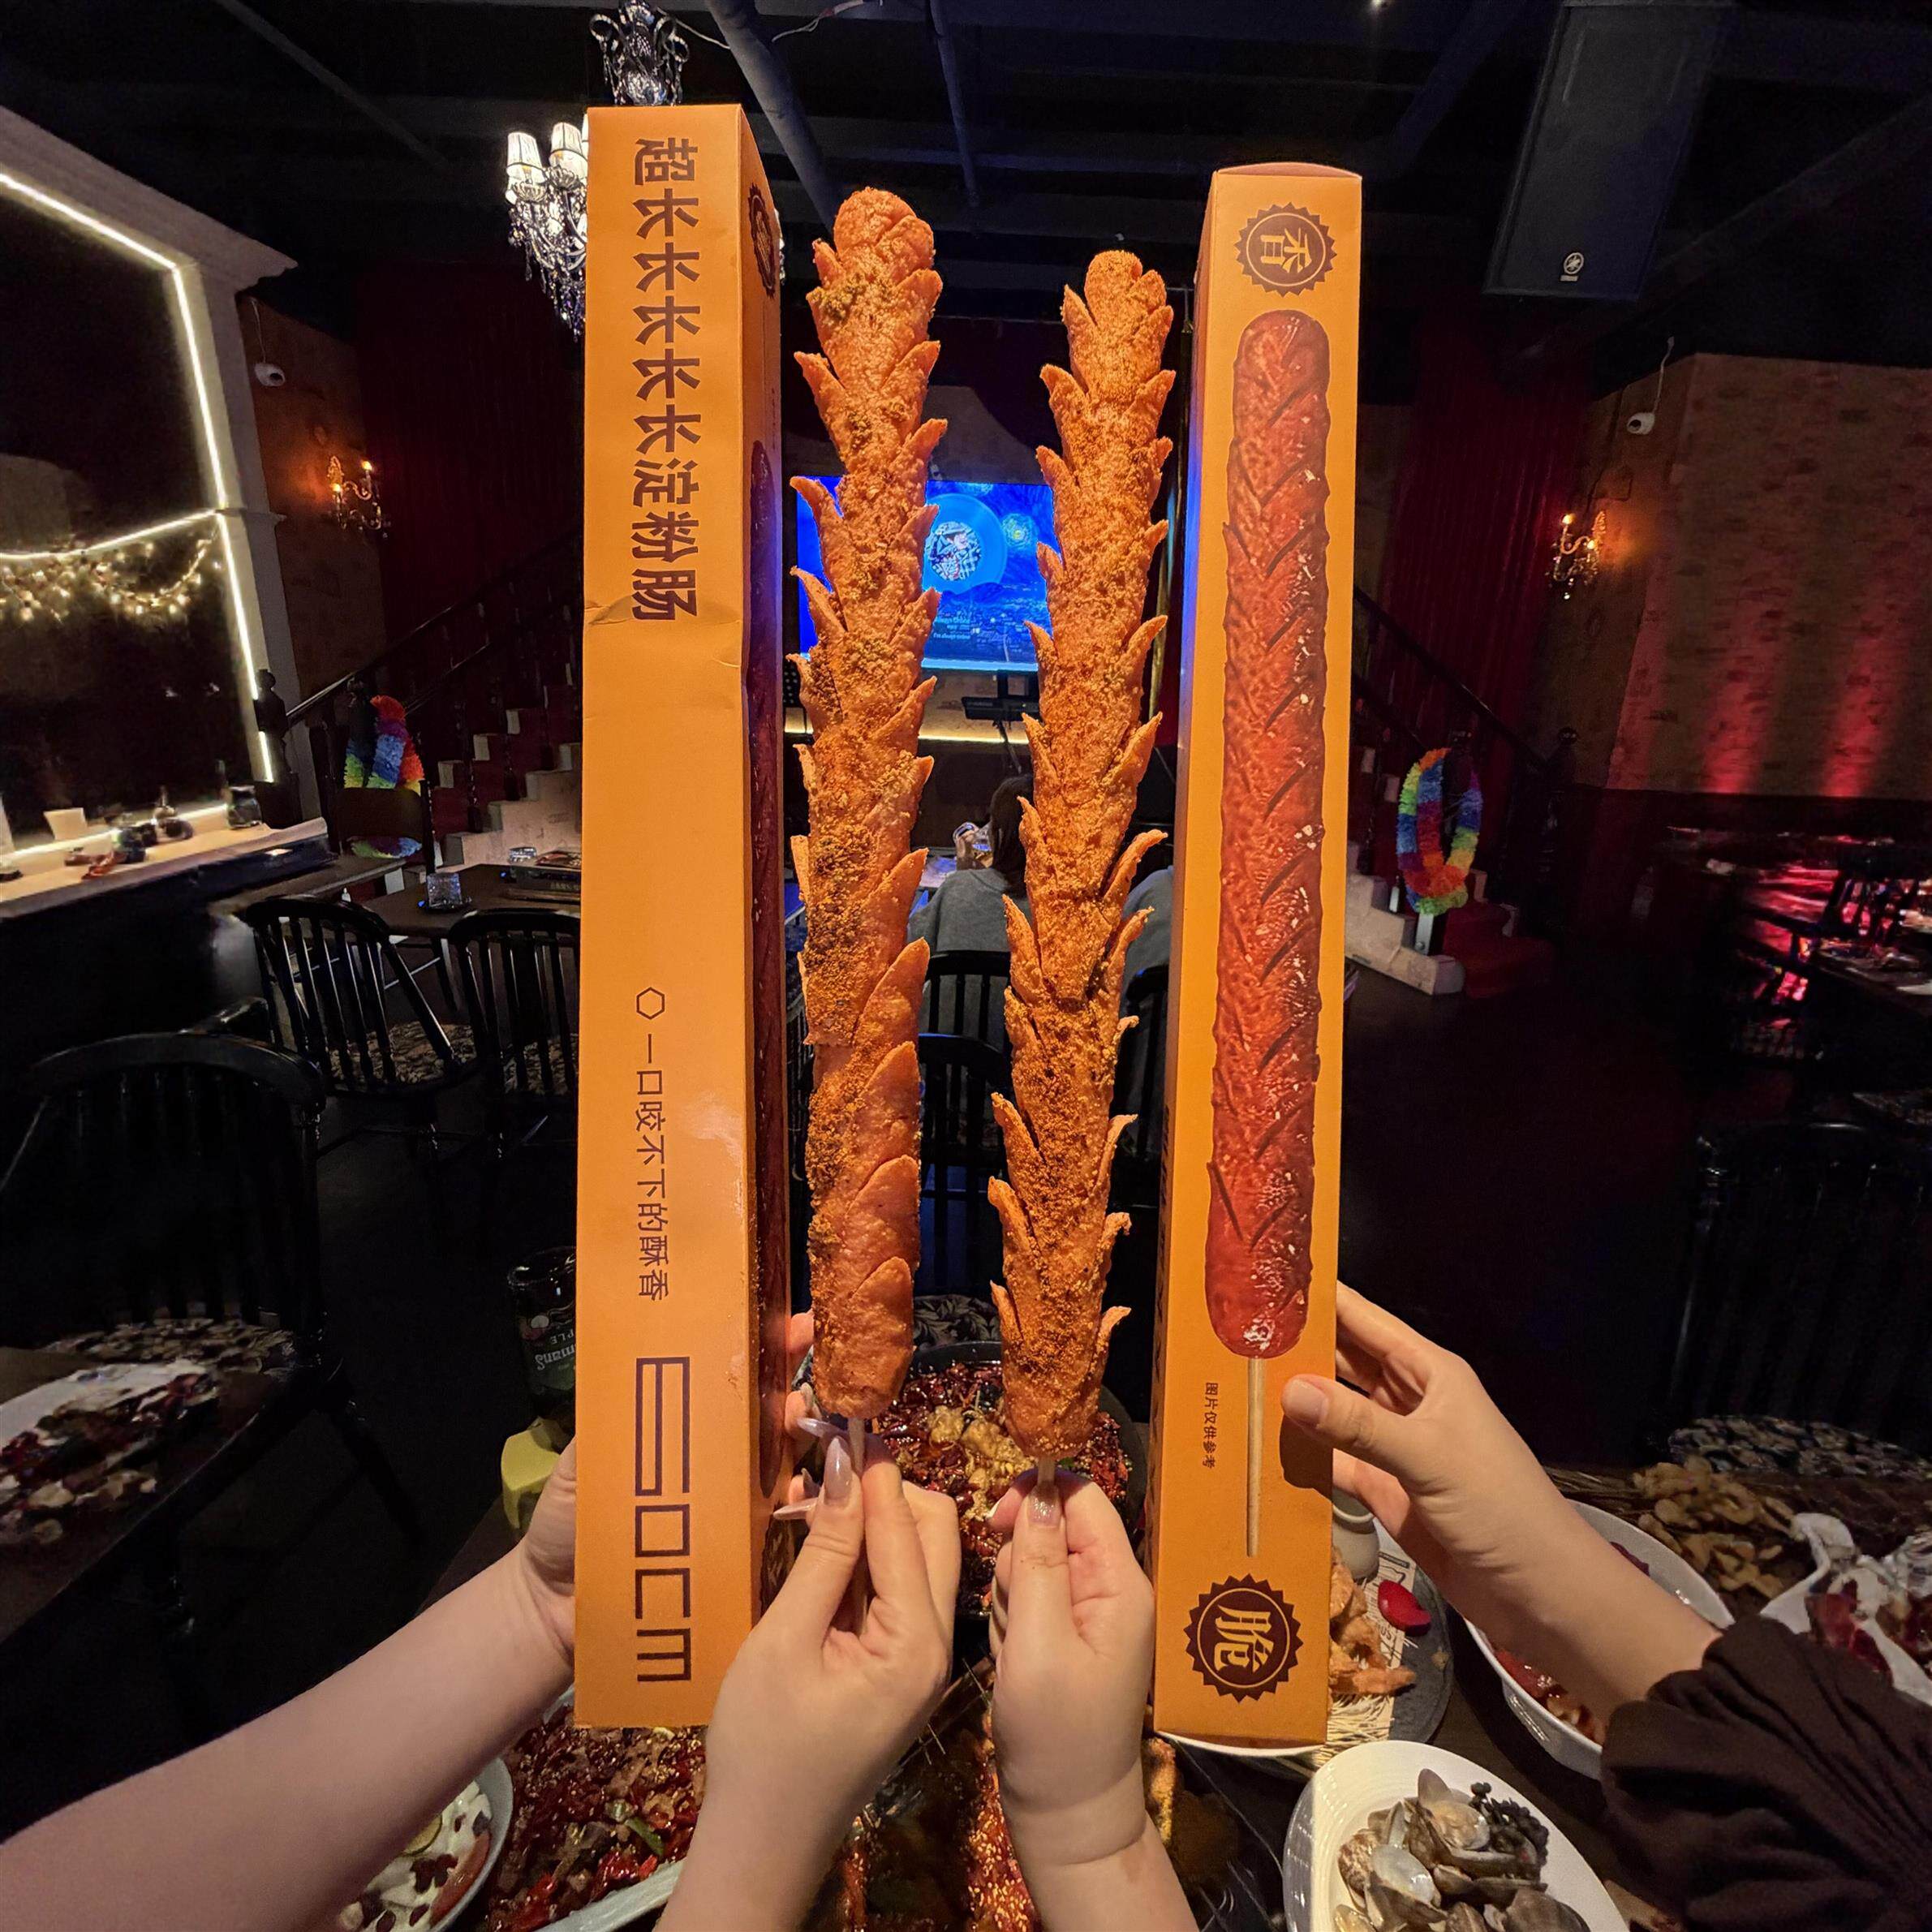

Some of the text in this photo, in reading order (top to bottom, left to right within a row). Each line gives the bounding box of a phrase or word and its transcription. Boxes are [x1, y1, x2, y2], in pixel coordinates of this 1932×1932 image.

[1260, 227, 1312, 273] 香
[631, 138, 700, 622] 超长长长长长淀粉肠
[636, 1033, 669, 1302] 一口咬不下的酥香
[1203, 1382, 1220, 1469] 图片仅供参考
[1214, 1603, 1275, 1673] 脆
